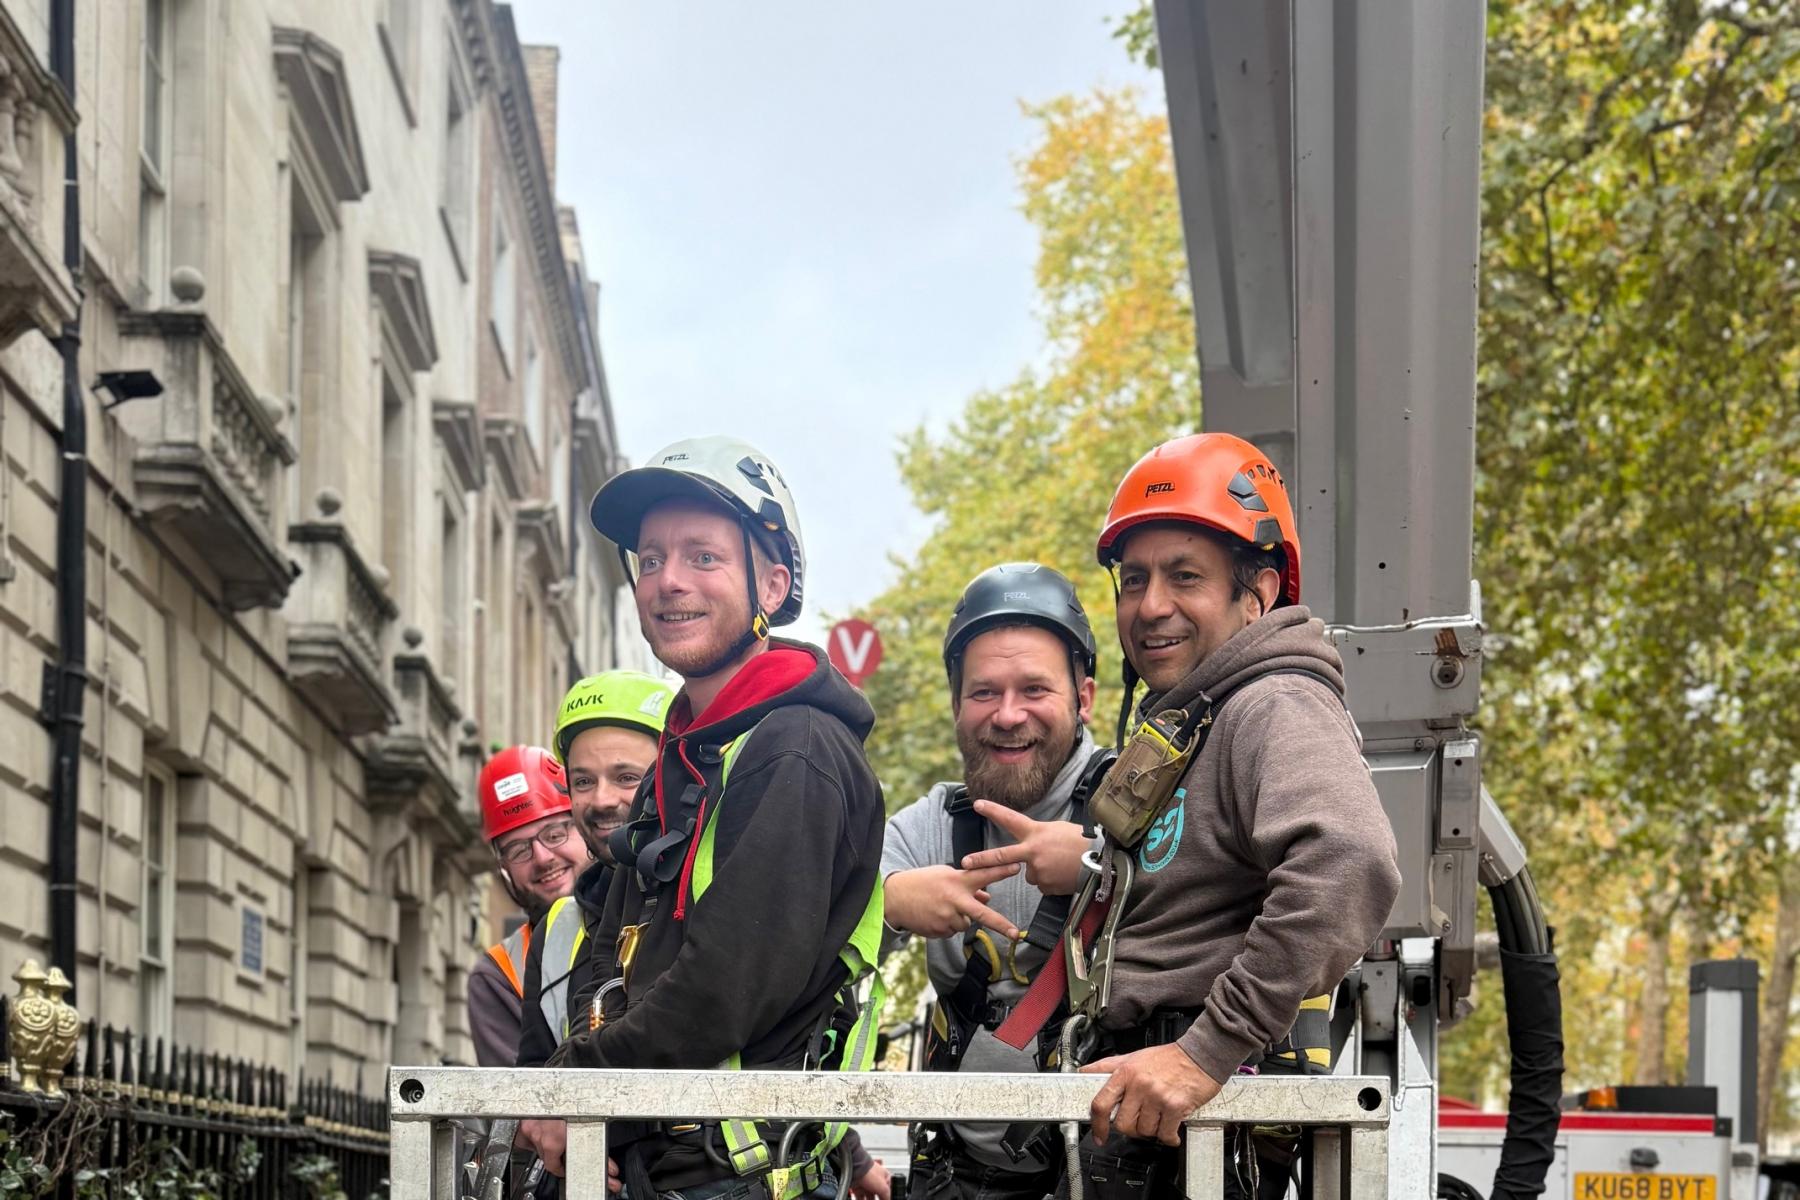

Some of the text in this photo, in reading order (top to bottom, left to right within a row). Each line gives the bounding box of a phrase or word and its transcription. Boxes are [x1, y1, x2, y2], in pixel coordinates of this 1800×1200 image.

[1145, 482, 1175, 498] PETZL
[836, 630, 875, 667] V
[566, 694, 604, 713] KASK
[1584, 1177, 1707, 1200] KU68 BYT
